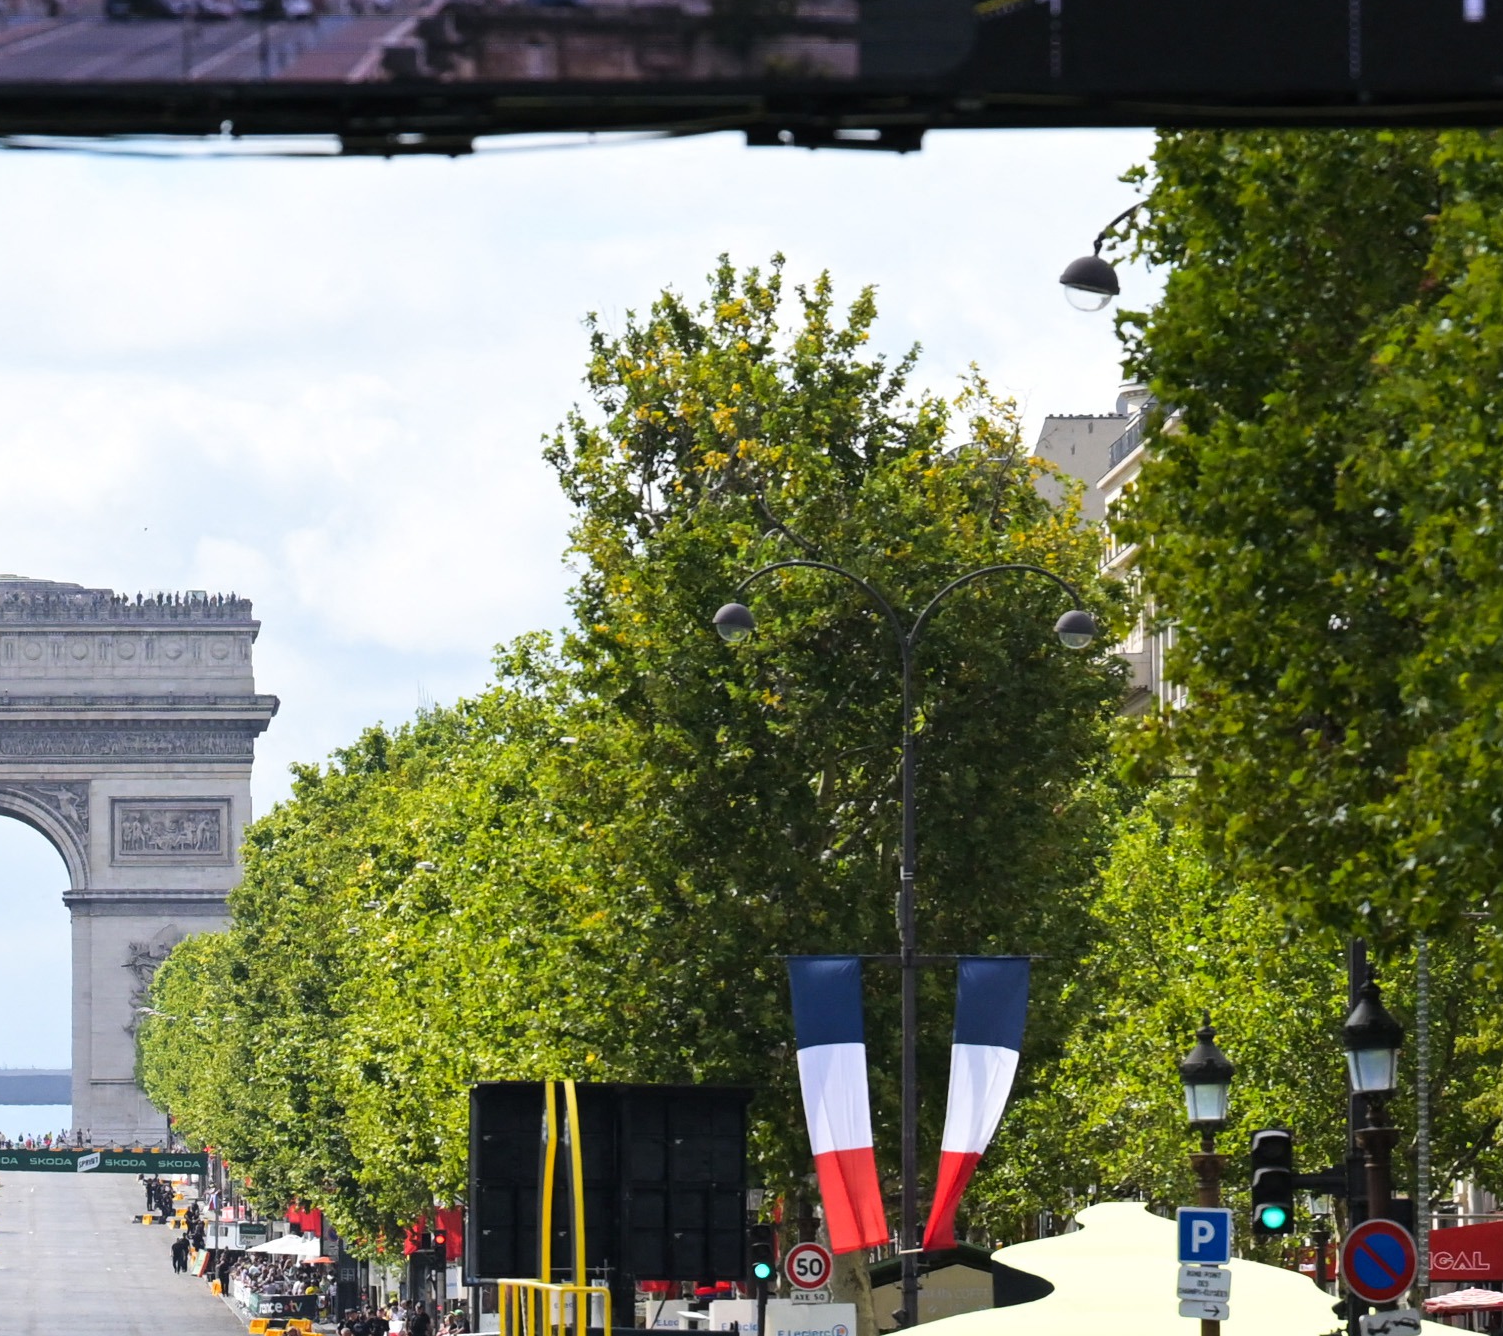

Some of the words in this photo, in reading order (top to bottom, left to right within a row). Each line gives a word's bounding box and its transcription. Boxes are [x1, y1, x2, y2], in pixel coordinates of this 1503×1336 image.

[29, 1157, 72, 1166] SKODA
[104, 1158, 147, 1167] SKODA
[158, 1160, 201, 1168] SKODA
[1191, 1220, 1215, 1253] P
[796, 1258, 823, 1277] 50
[812, 1293, 825, 1301] 50
